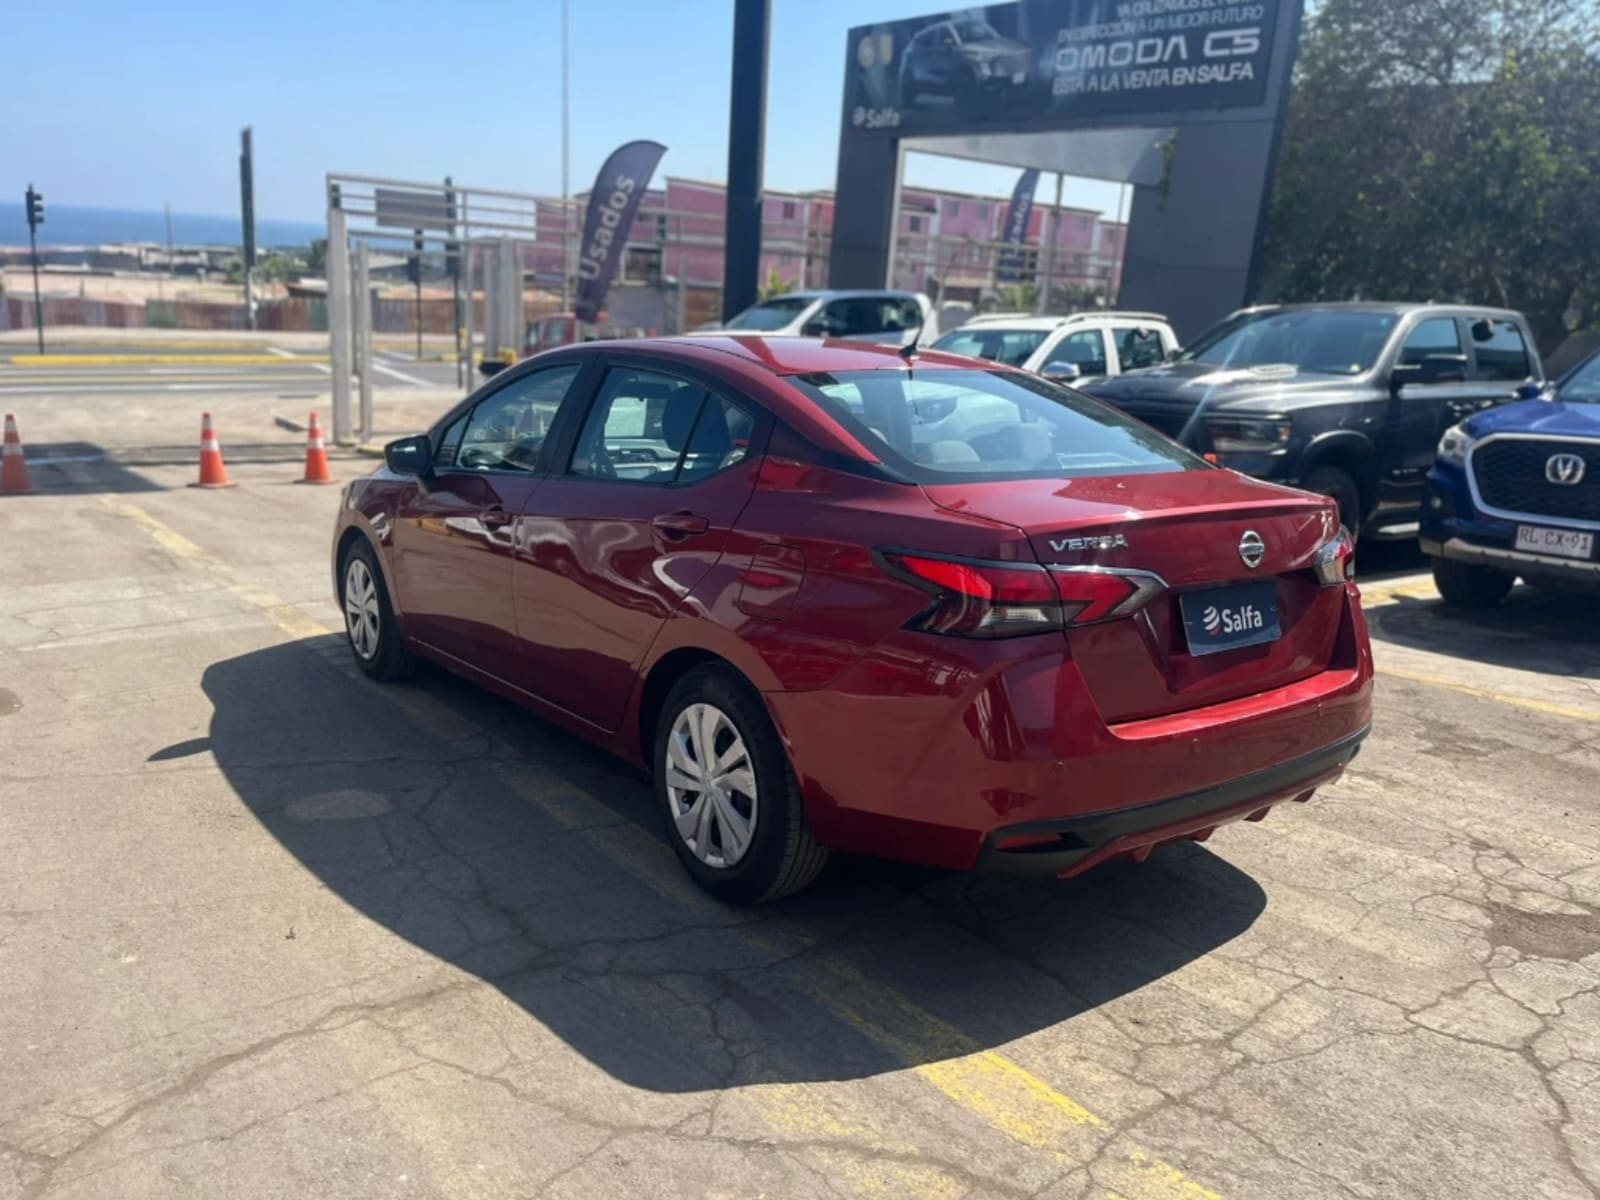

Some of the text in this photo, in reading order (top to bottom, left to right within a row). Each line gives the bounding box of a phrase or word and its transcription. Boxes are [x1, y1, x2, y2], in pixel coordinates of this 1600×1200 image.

[1211, 4, 1264, 25] FUTURO
[1056, 27, 1261, 72] OMODA C5
[1087, 74, 1099, 92] A
[1100, 71, 1120, 92] LA
[1122, 67, 1170, 90] VENTA
[1172, 65, 1198, 87] EN
[1197, 61, 1255, 84] SALFA
[579, 174, 636, 280] Usados
[1048, 534, 1129, 553] VERSA
[1519, 527, 1538, 545] RL
[1221, 604, 1263, 634] Salfa
